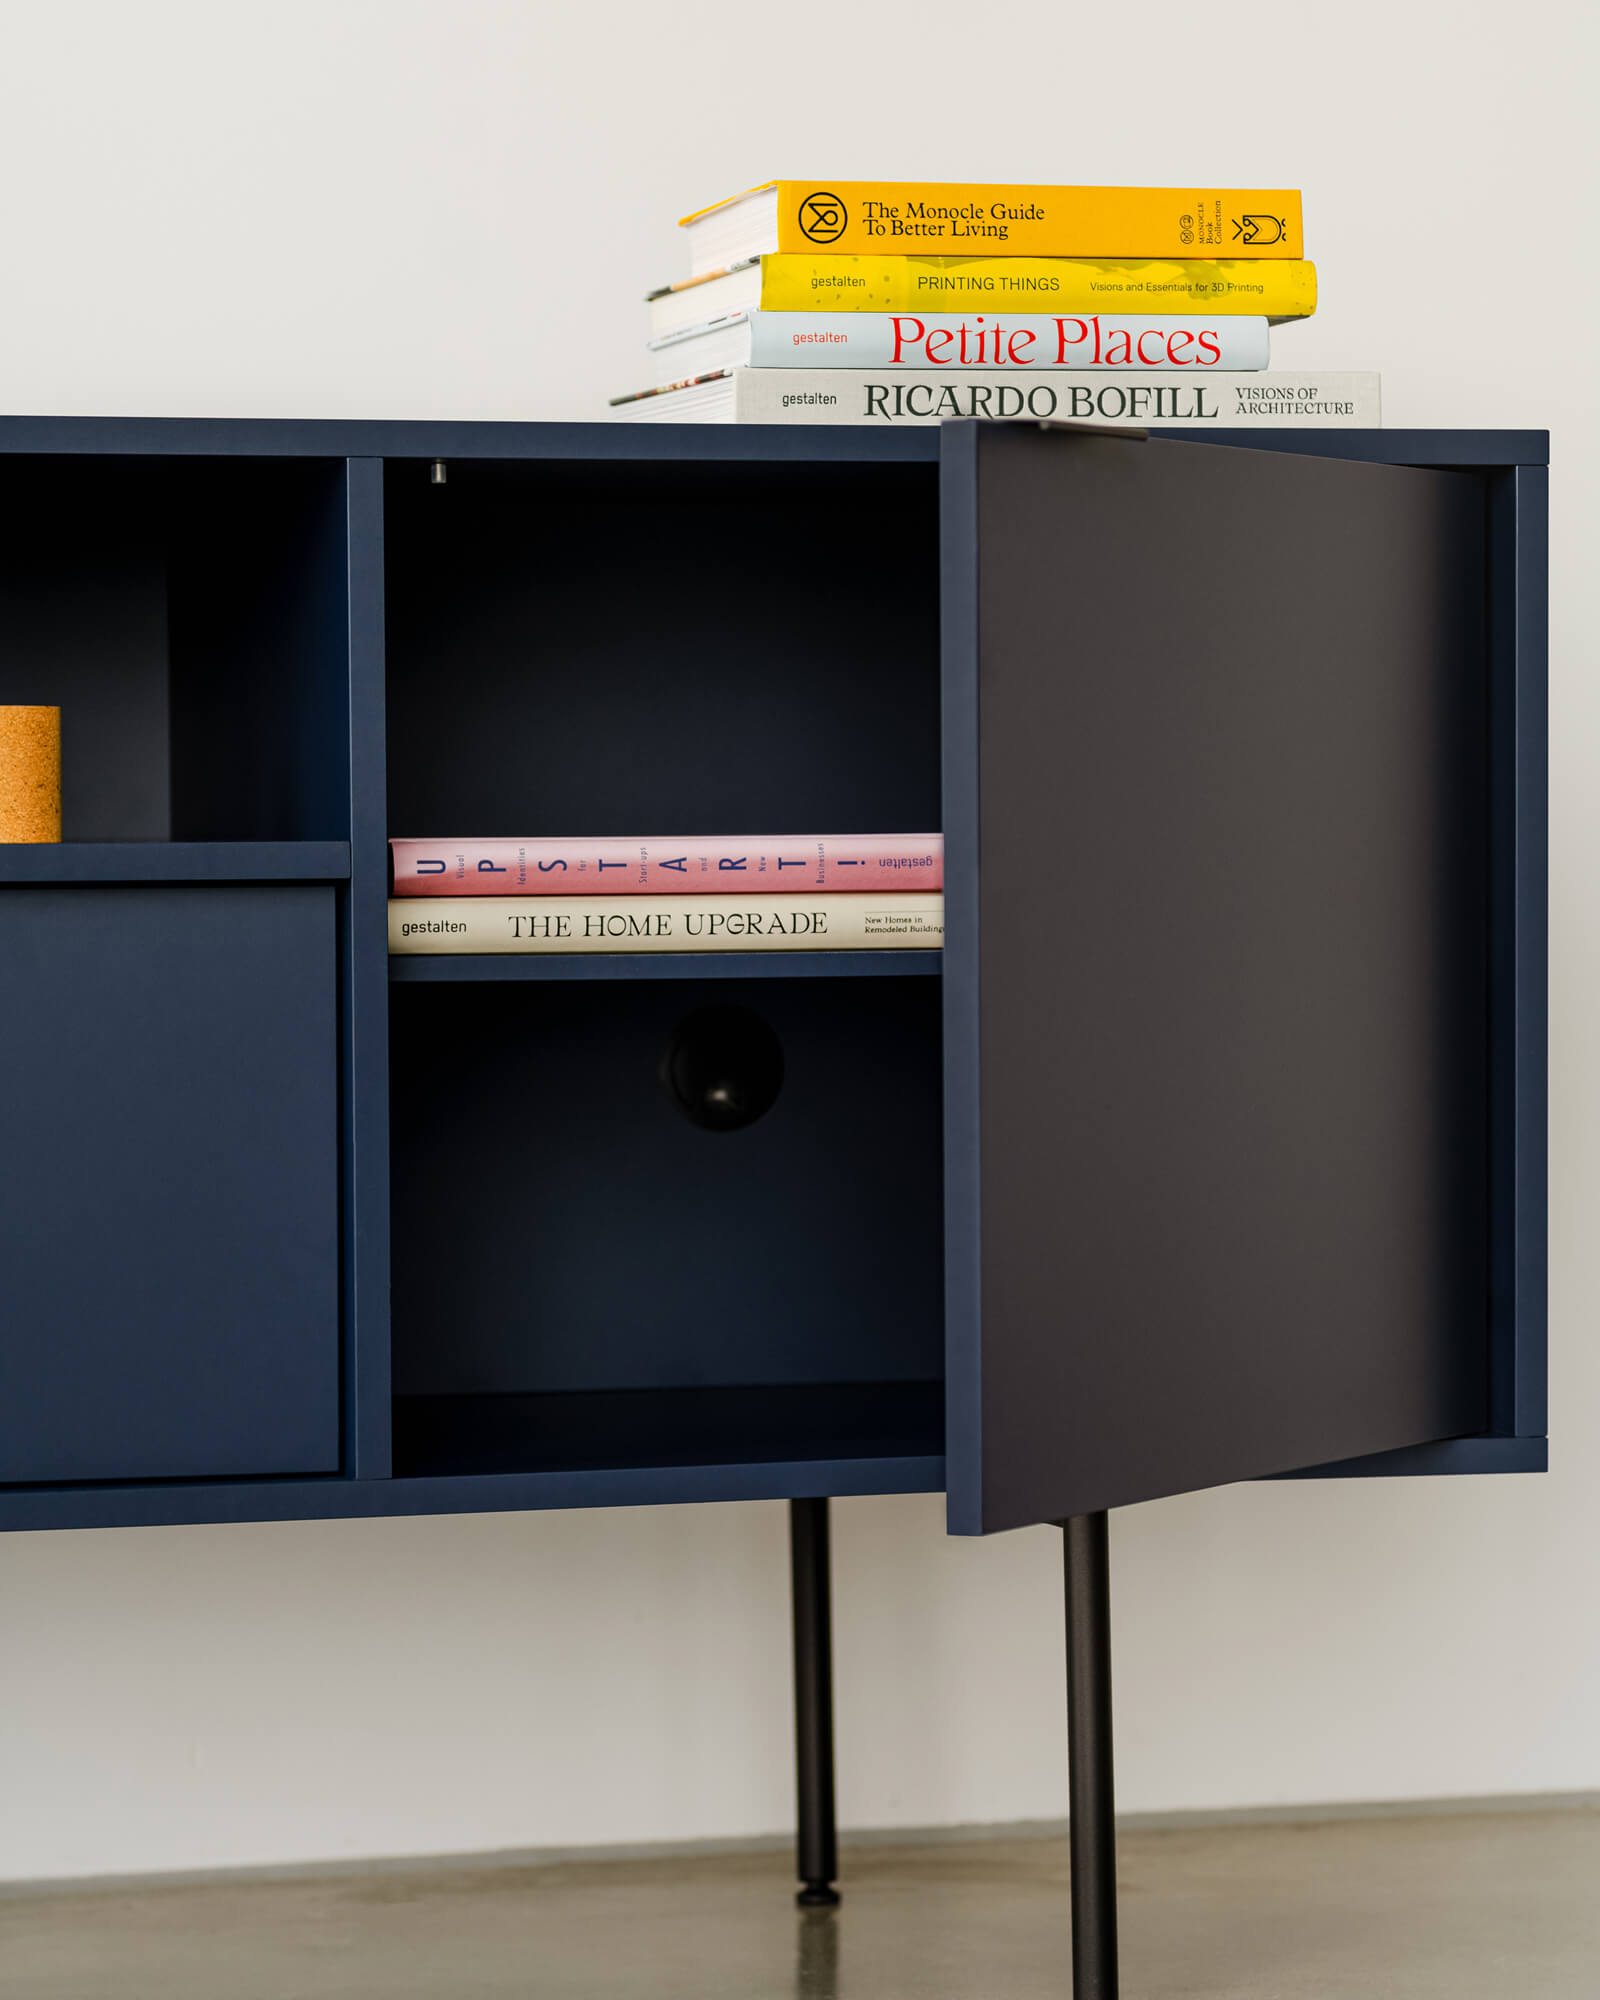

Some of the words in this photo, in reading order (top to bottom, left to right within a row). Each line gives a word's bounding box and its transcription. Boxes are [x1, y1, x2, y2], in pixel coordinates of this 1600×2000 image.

[863, 202, 898, 218] The
[906, 203, 984, 219] Monocle
[991, 204, 1045, 220] Guide
[1214, 201, 1222, 244] Collection
[863, 220, 885, 236] To
[892, 221, 945, 236] Better
[952, 221, 1008, 239] Living
[811, 276, 865, 288] gestalten
[918, 277, 994, 290] PRINTING
[1000, 278, 1060, 290] THINGS
[1091, 282, 1123, 291] Visions
[1126, 282, 1143, 291] and
[1146, 283, 1192, 292] Essentials
[1195, 282, 1208, 292] for
[1212, 283, 1224, 292] 3D
[1228, 283, 1263, 294] Printing
[793, 332, 847, 345] gestalten
[888, 317, 1036, 364] Petite
[1051, 315, 1221, 367] Places
[782, 393, 836, 406] gestalten
[1236, 387, 1294, 399] VISIONS
[1297, 388, 1318, 399] OF
[864, 384, 1057, 420] RICARDO
[1068, 386, 1218, 418] BOFILL
[1236, 402, 1353, 415] ARCHITECTURE
[456, 854, 464, 879] Visual
[518, 847, 526, 885] Identities
[879, 856, 933, 867] gestalten
[402, 920, 466, 936] gestalten
[508, 915, 571, 938] THE
[583, 914, 672, 937] HOME
[684, 912, 828, 935] UPGRADE
[865, 926, 907, 934] Remodeled
